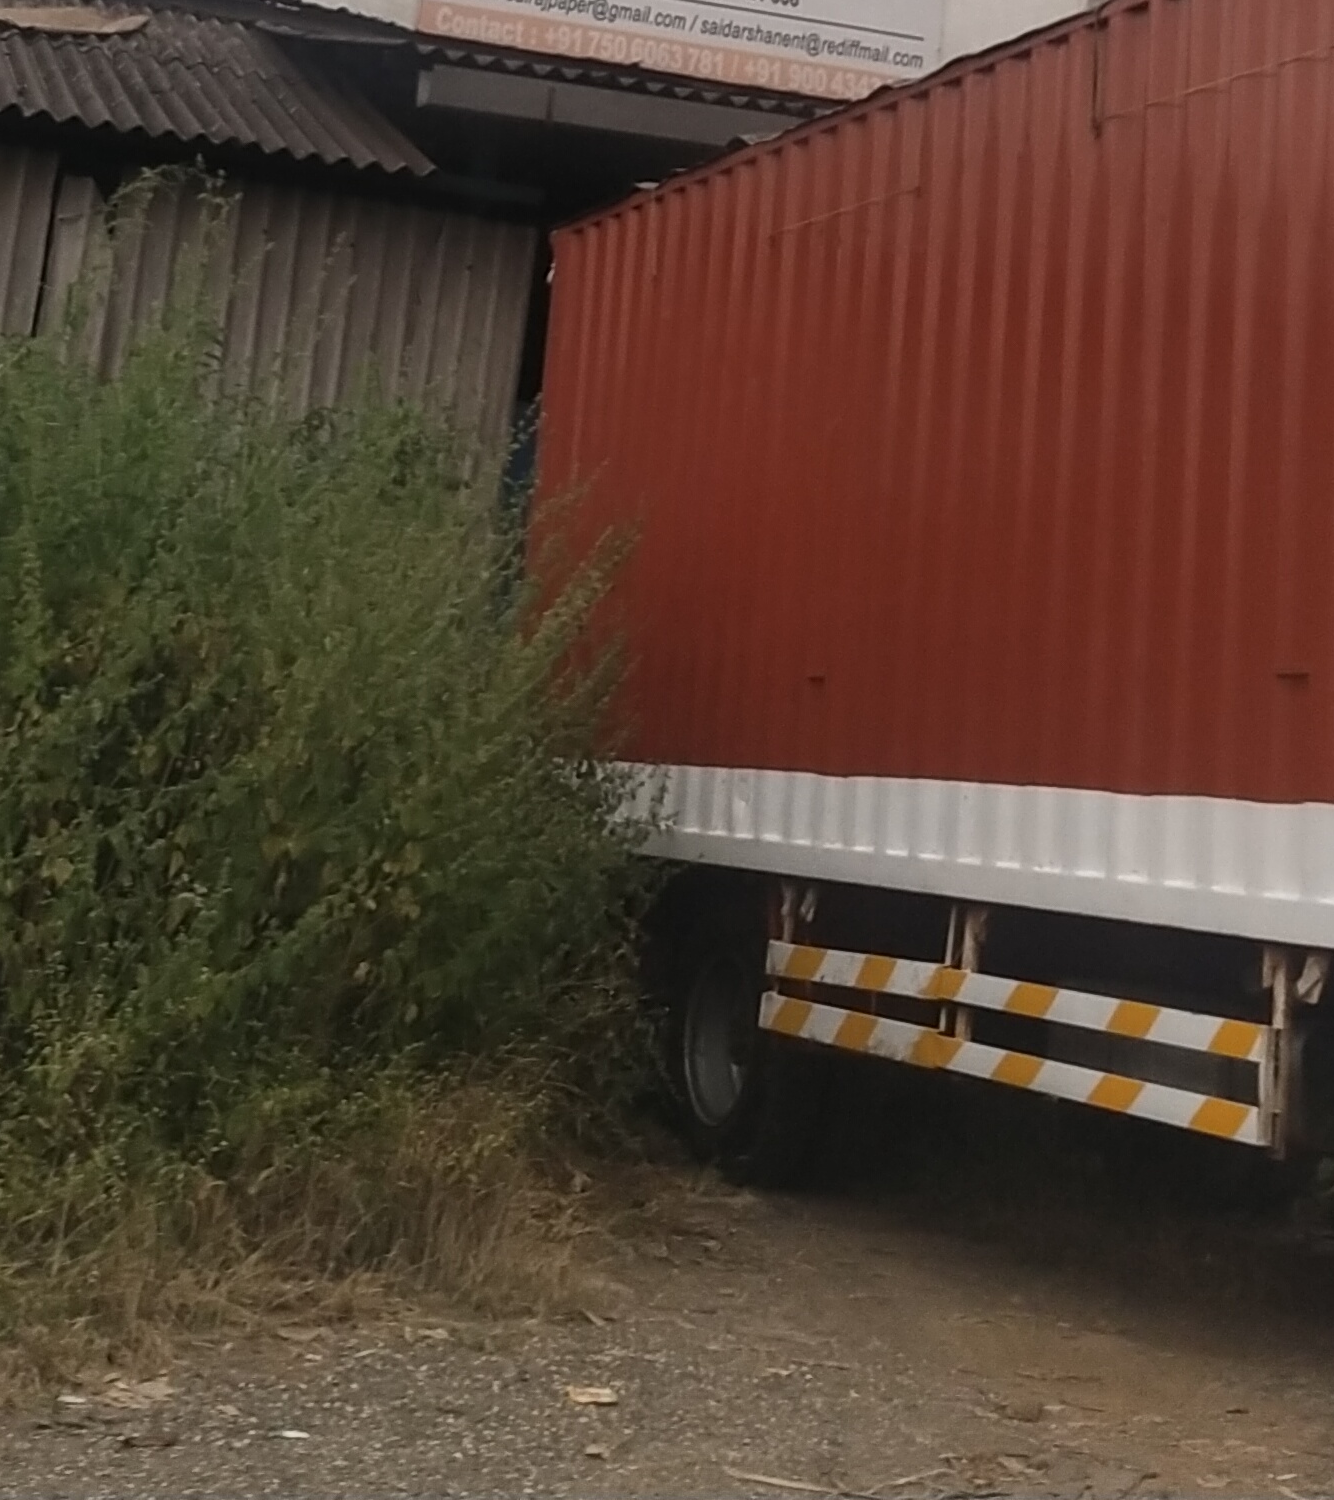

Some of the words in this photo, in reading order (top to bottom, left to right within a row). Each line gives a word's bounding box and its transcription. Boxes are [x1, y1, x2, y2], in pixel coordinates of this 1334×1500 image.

[435, 6, 525, 44] Contact
[545, 24, 582, 55] +91
[587, 31, 628, 62] 750
[687, 48, 725, 77] 781
[744, 58, 782, 87] +91
